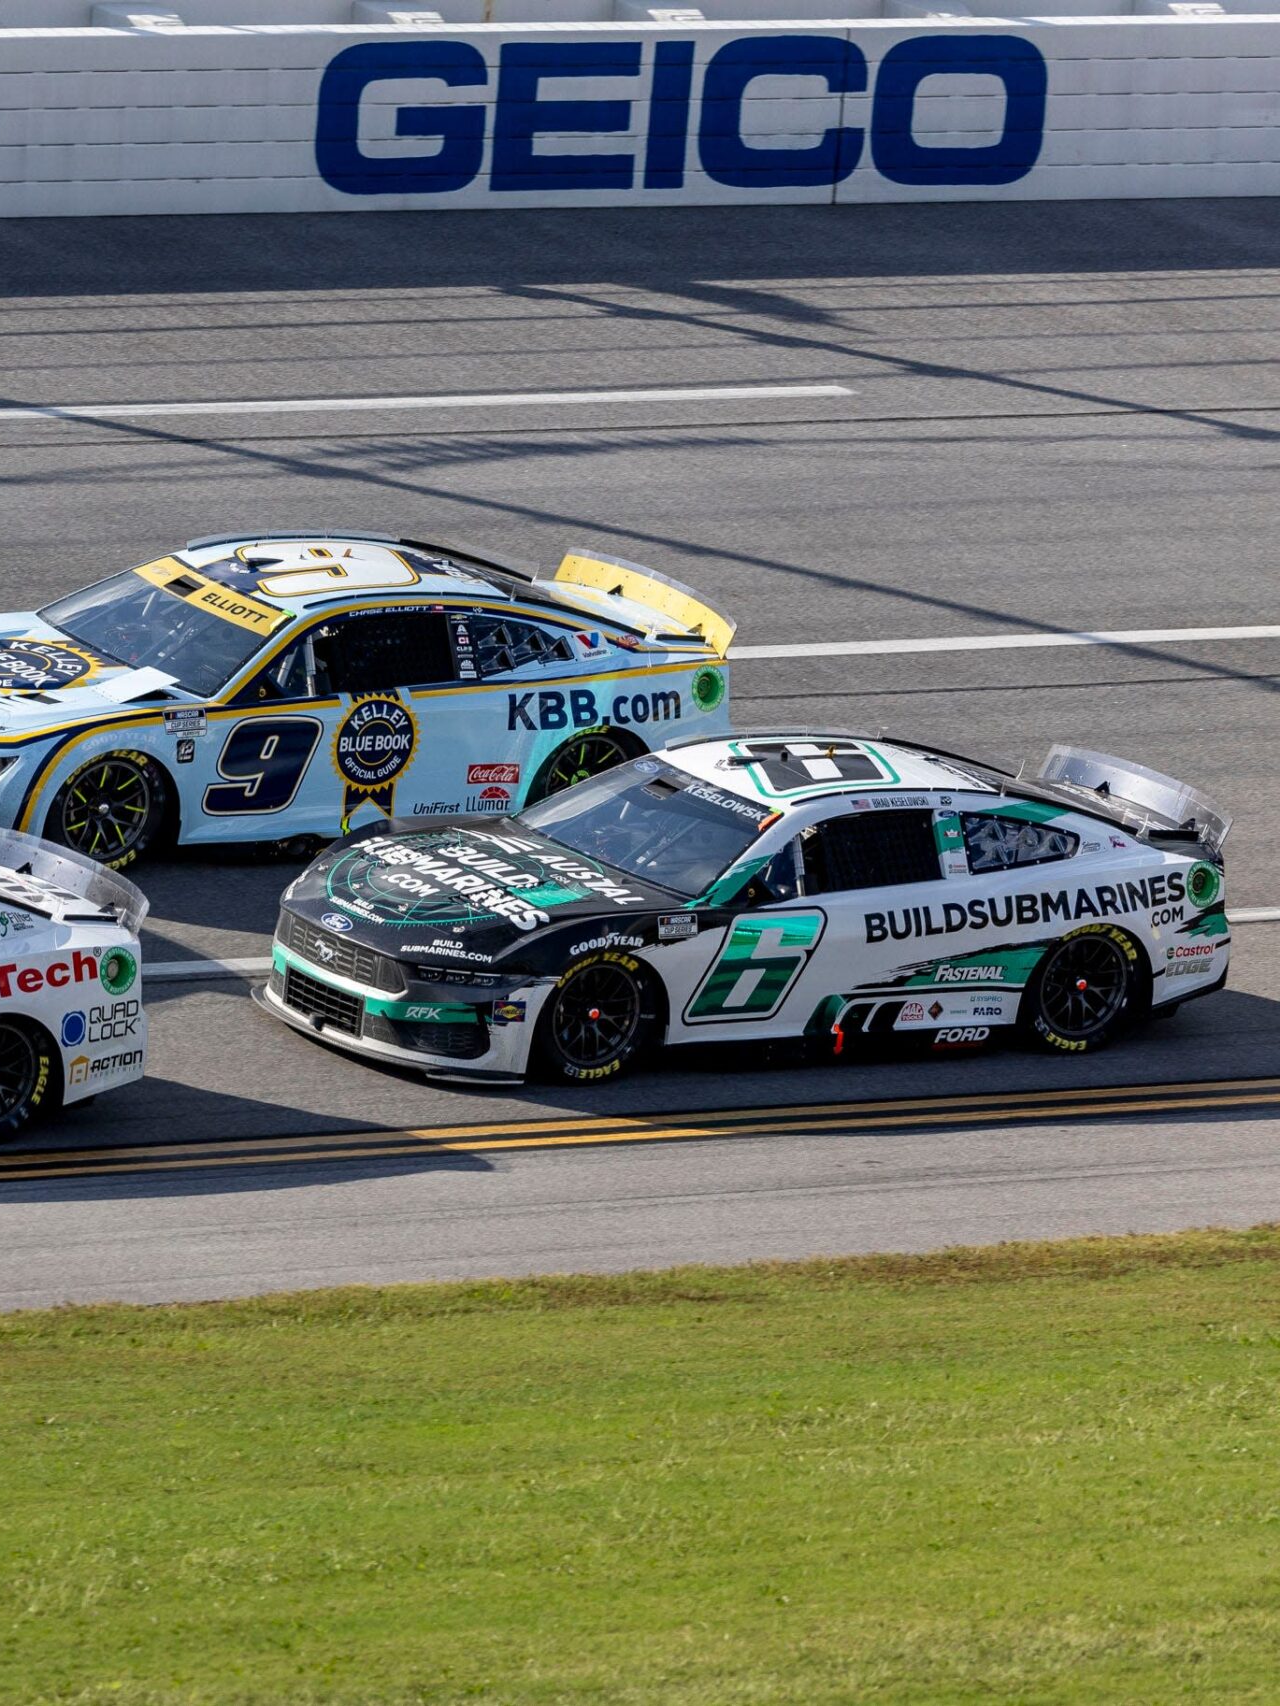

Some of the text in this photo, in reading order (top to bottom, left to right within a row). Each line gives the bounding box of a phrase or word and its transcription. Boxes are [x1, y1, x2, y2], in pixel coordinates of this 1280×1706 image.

[316, 34, 1047, 195] GEICO
[201, 592, 268, 624] ELLIOTT
[349, 605, 429, 617] CHASE ELLIOTT
[10, 641, 82, 677] KELLEY
[0, 660, 59, 688] BOOK
[350, 703, 409, 730] KELLEY
[507, 688, 681, 732] KBB.com
[183, 720, 201, 728] SERIES
[339, 734, 411, 752] BLUE BOOK
[201, 714, 324, 816] 9
[344, 755, 402, 779] OFFICIAL GUIDE
[468, 764, 519, 783] Coca-Cola
[413, 801, 461, 815] UniFirst
[465, 796, 511, 812] LLumar
[872, 797, 889, 808] BRAD
[890, 796, 929, 808] KESELOWSKI
[437, 846, 540, 889] BUILD
[549, 873, 571, 884] USA
[380, 873, 441, 898] .COM
[528, 853, 645, 906] AUSTAL
[865, 871, 1186, 944] BUILDSUBMARINES
[1150, 905, 1184, 929] .COM
[323, 914, 351, 929] Ford
[400, 945, 493, 963] SUBMARINES.COM
[432, 939, 463, 949] BUILD
[570, 932, 644, 955] GOODYEAR
[1176, 943, 1214, 958] Castrol
[682, 905, 828, 1027] 6
[934, 964, 1004, 982] FASTENAL
[1166, 958, 1213, 978] EDGE
[89, 1000, 139, 1024] QUAD
[405, 1006, 442, 1020] RFK
[972, 1007, 1002, 1016] FARO
[88, 1018, 138, 1043] LOCK
[934, 1027, 990, 1043] FORD
[90, 1050, 143, 1073] ACTION
[579, 1058, 621, 1079] EAGLE
[31, 1056, 50, 1105] EAGLE
